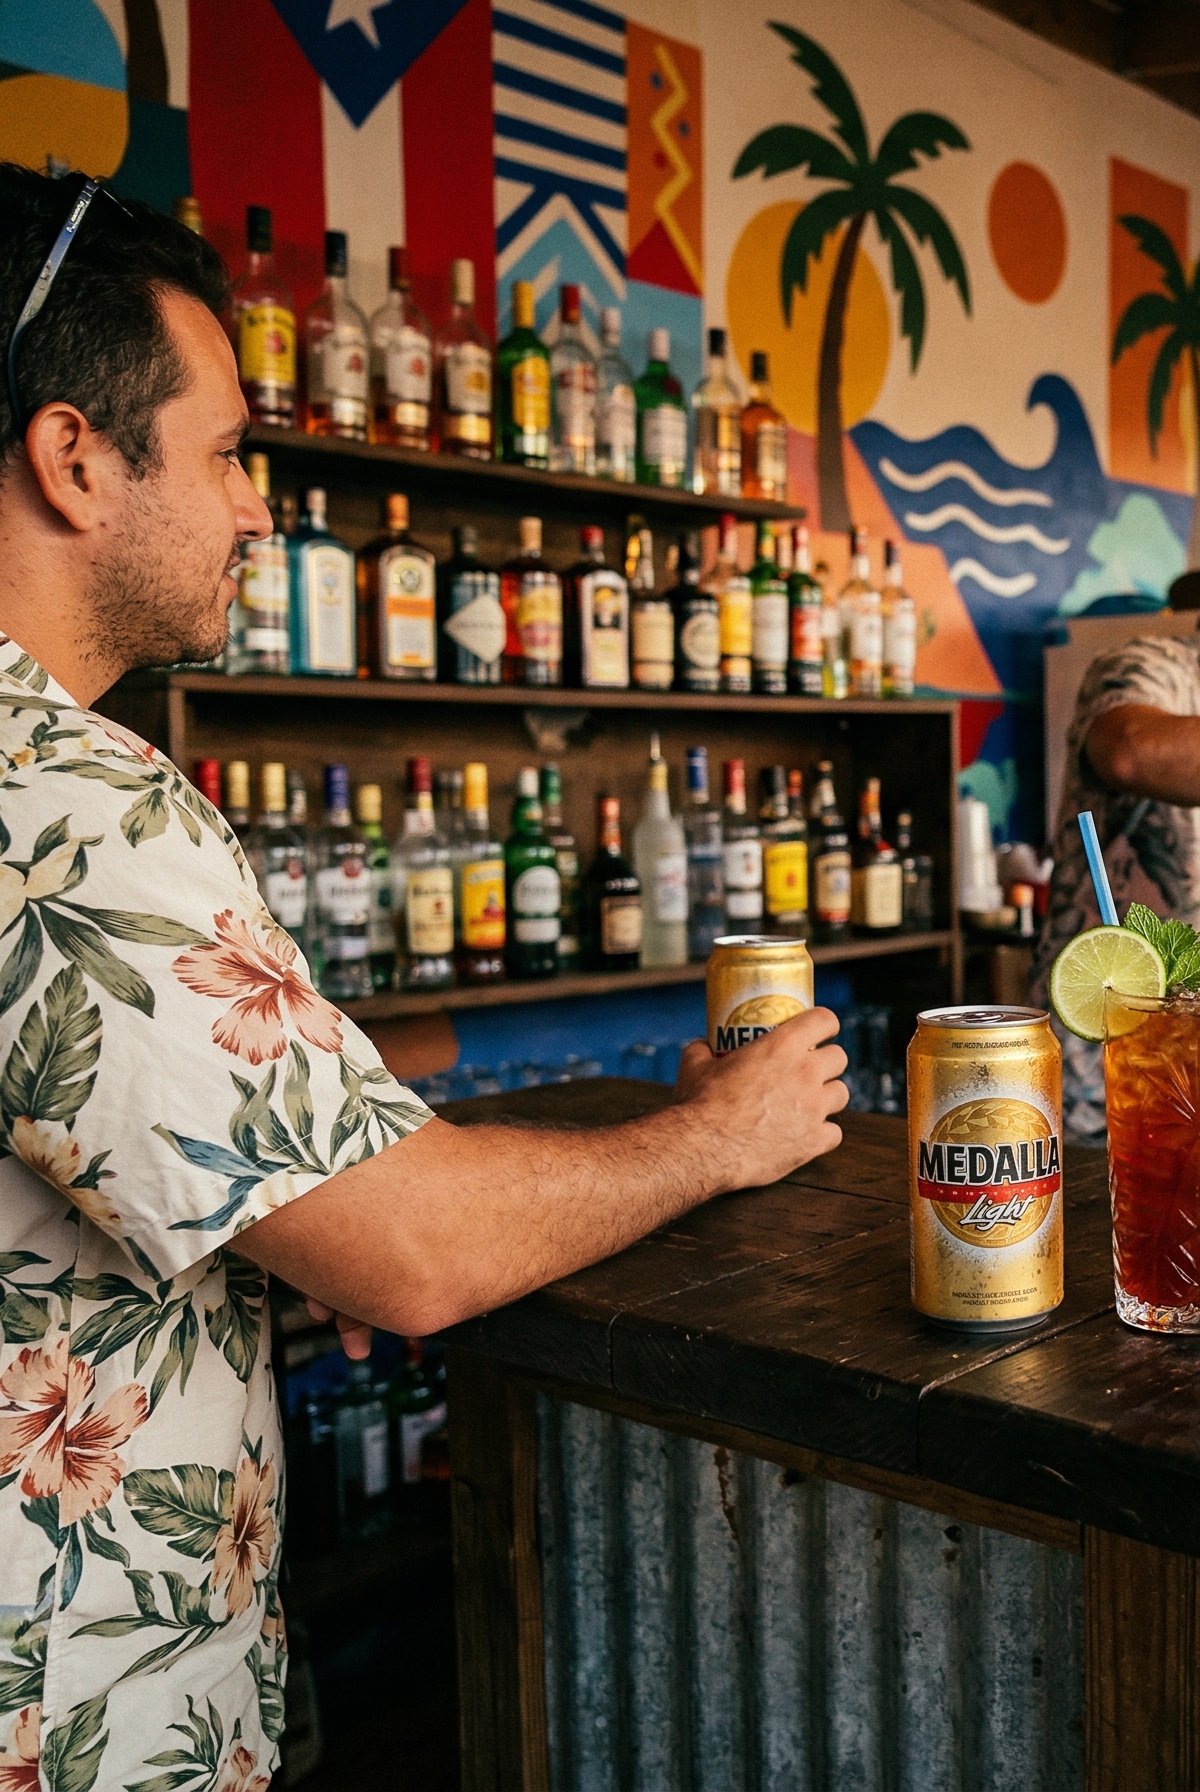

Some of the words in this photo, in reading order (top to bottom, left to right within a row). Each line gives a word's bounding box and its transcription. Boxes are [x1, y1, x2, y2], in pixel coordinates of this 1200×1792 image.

[716, 1025, 778, 1052] MED
[918, 1135, 1061, 1186] MEDALLA
[959, 1194, 1036, 1231] Light
